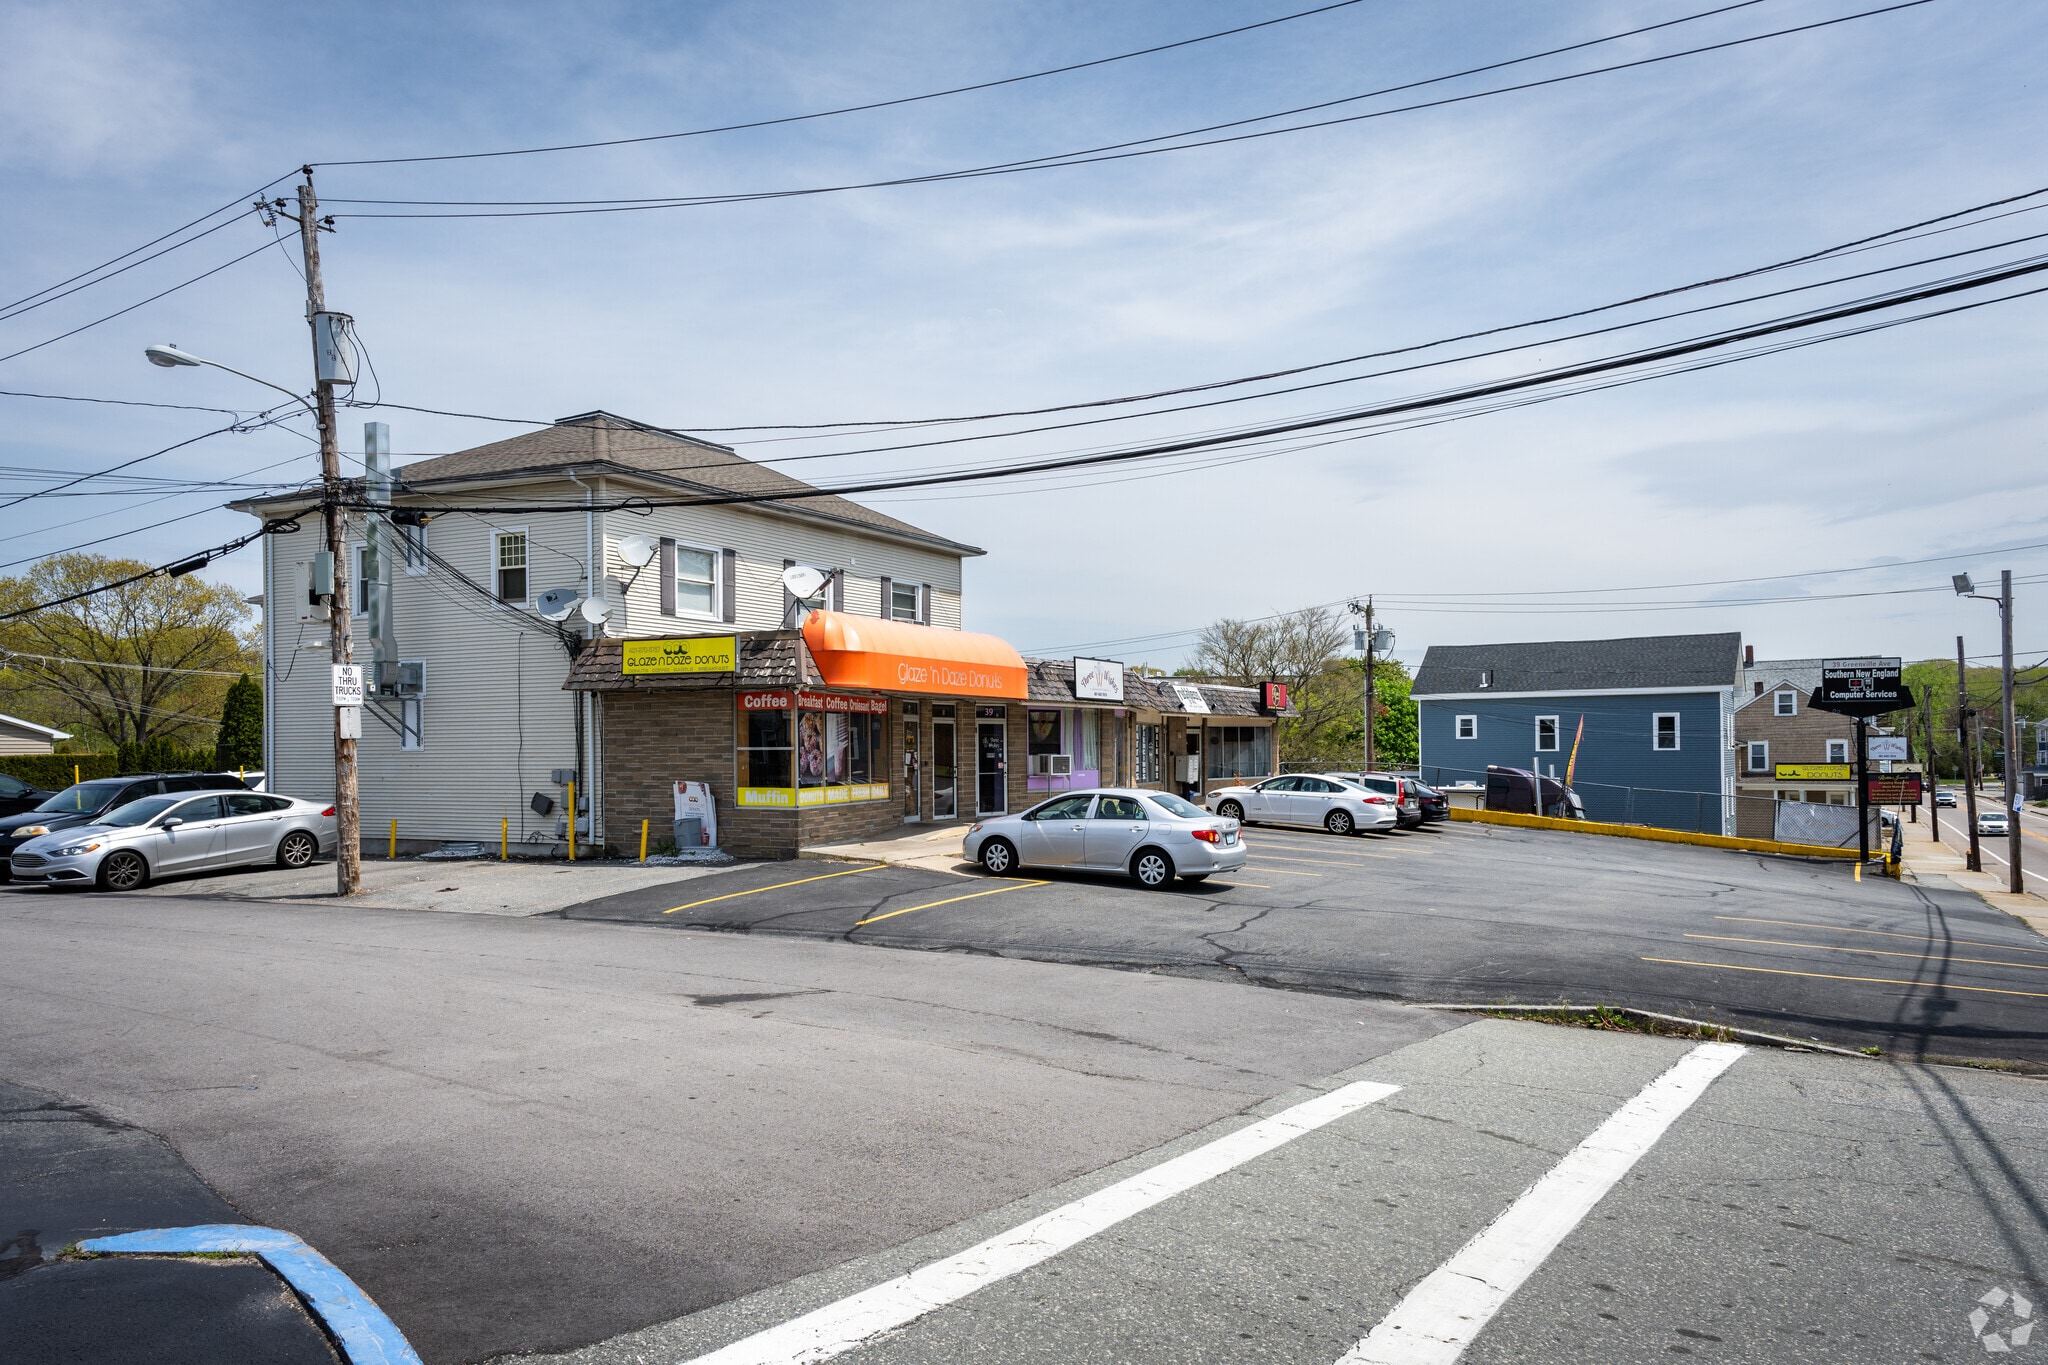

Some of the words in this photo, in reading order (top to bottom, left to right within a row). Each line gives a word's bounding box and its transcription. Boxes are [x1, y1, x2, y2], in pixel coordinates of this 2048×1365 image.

[342, 667, 353, 676] NO
[897, 662, 928, 685] Glaze
[941, 667, 967, 687] Daze
[969, 669, 1003, 689] Donuts
[1824, 669, 1855, 679] Southern
[1856, 669, 1871, 678] New
[1872, 668, 1899, 679] England
[338, 676, 358, 686] THRU
[335, 685, 362, 696] TRUCKS
[1829, 690, 1864, 700] Computer
[1865, 690, 1898, 698] Services
[744, 694, 788, 708] Coffee
[798, 694, 824, 709] Breakfast
[825, 695, 848, 710] Coffee
[849, 698, 870, 712] Croissant
[870, 699, 888, 714] Bagel
[984, 707, 994, 716] 39
[745, 790, 789, 804] Muffin
[799, 788, 823, 804] DONUTS
[827, 787, 849, 801] MADE
[851, 785, 870, 798] FRESH
[870, 784, 888, 797] DAILY
